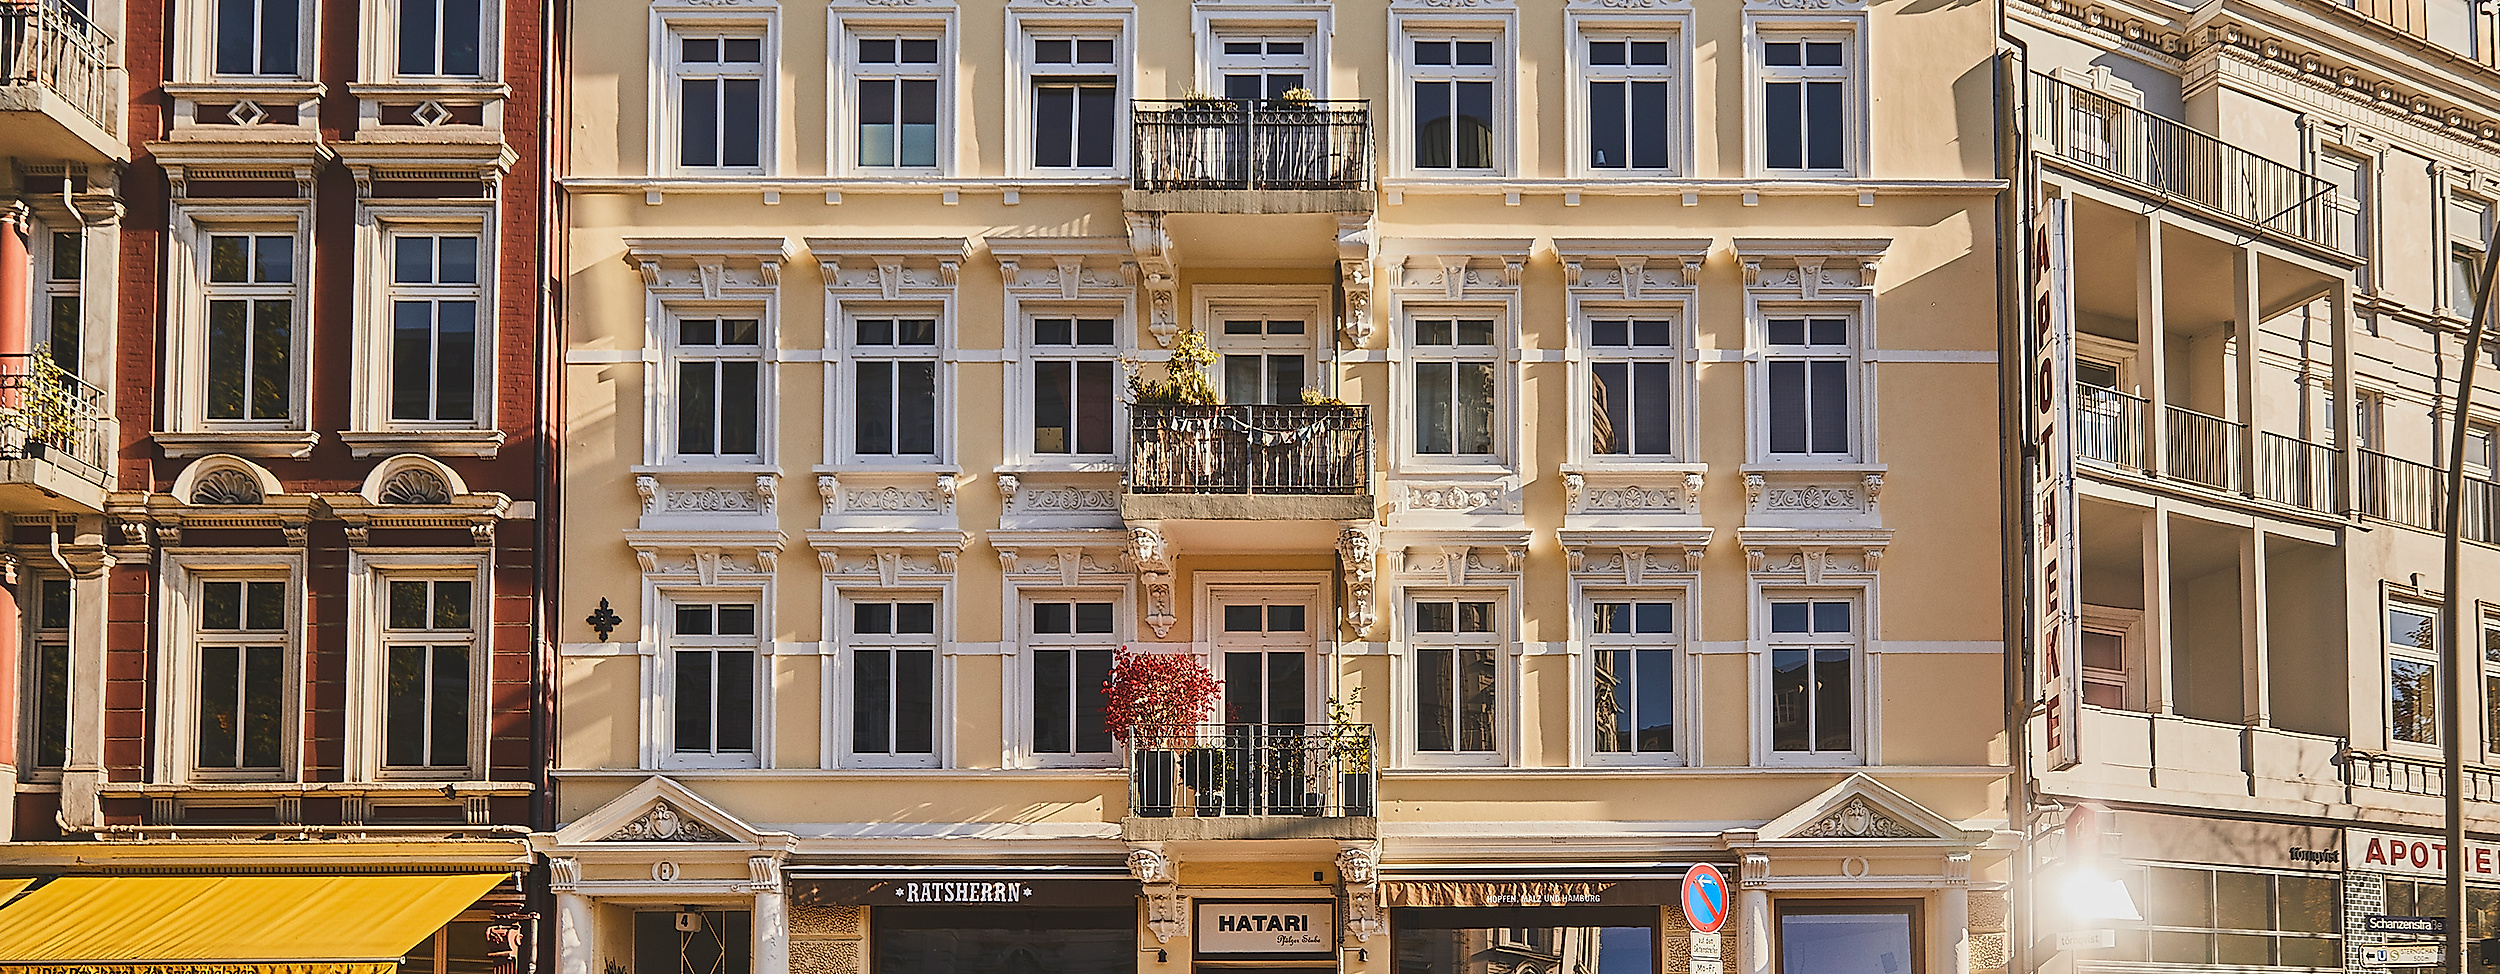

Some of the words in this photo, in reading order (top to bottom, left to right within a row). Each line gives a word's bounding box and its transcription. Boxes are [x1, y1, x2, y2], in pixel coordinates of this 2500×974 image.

[2037, 223, 2061, 753] APOTHEKE
[906, 882, 1021, 902] RATSHERRN
[1486, 894, 1519, 904] HOPFEN,
[1521, 894, 1542, 903] MALZ
[1544, 894, 1561, 903] UND
[1562, 894, 1600, 903] HAMBURG
[681, 914, 689, 928] 4
[1218, 915, 1308, 932] HATARI
[2369, 917, 2443, 931] Schanzenstraße
